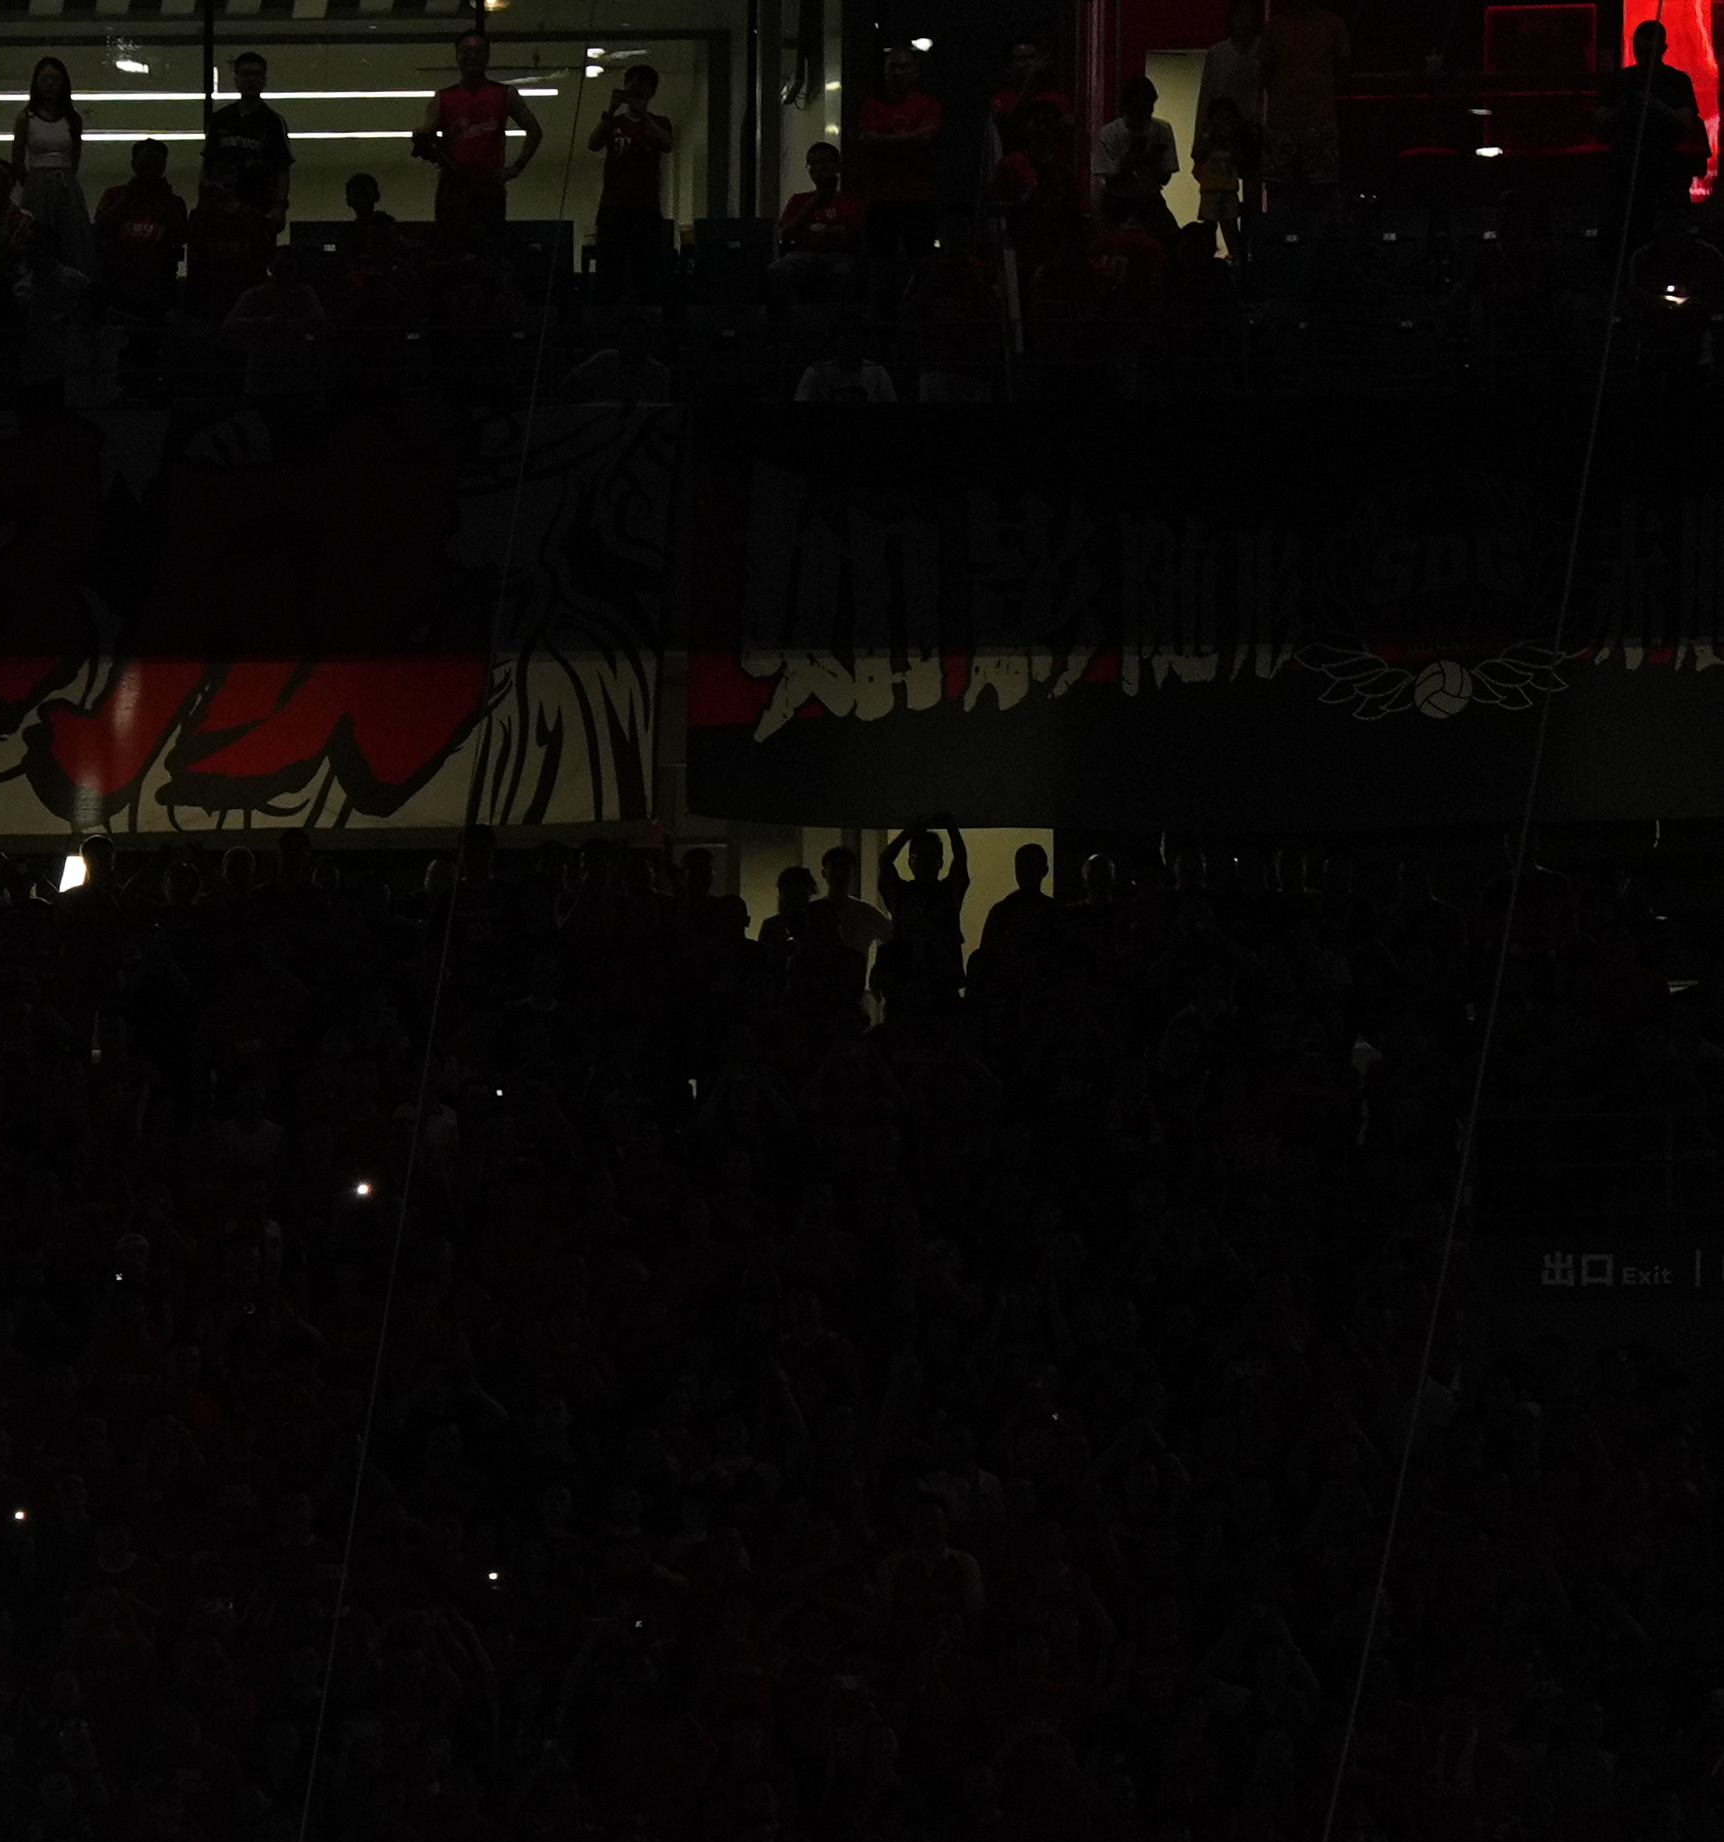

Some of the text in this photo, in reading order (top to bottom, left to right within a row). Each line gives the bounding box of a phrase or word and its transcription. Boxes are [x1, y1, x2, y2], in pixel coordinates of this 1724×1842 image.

[1366, 528, 1526, 606] SDG
[1541, 1251, 1672, 1287] 出口 Exit
